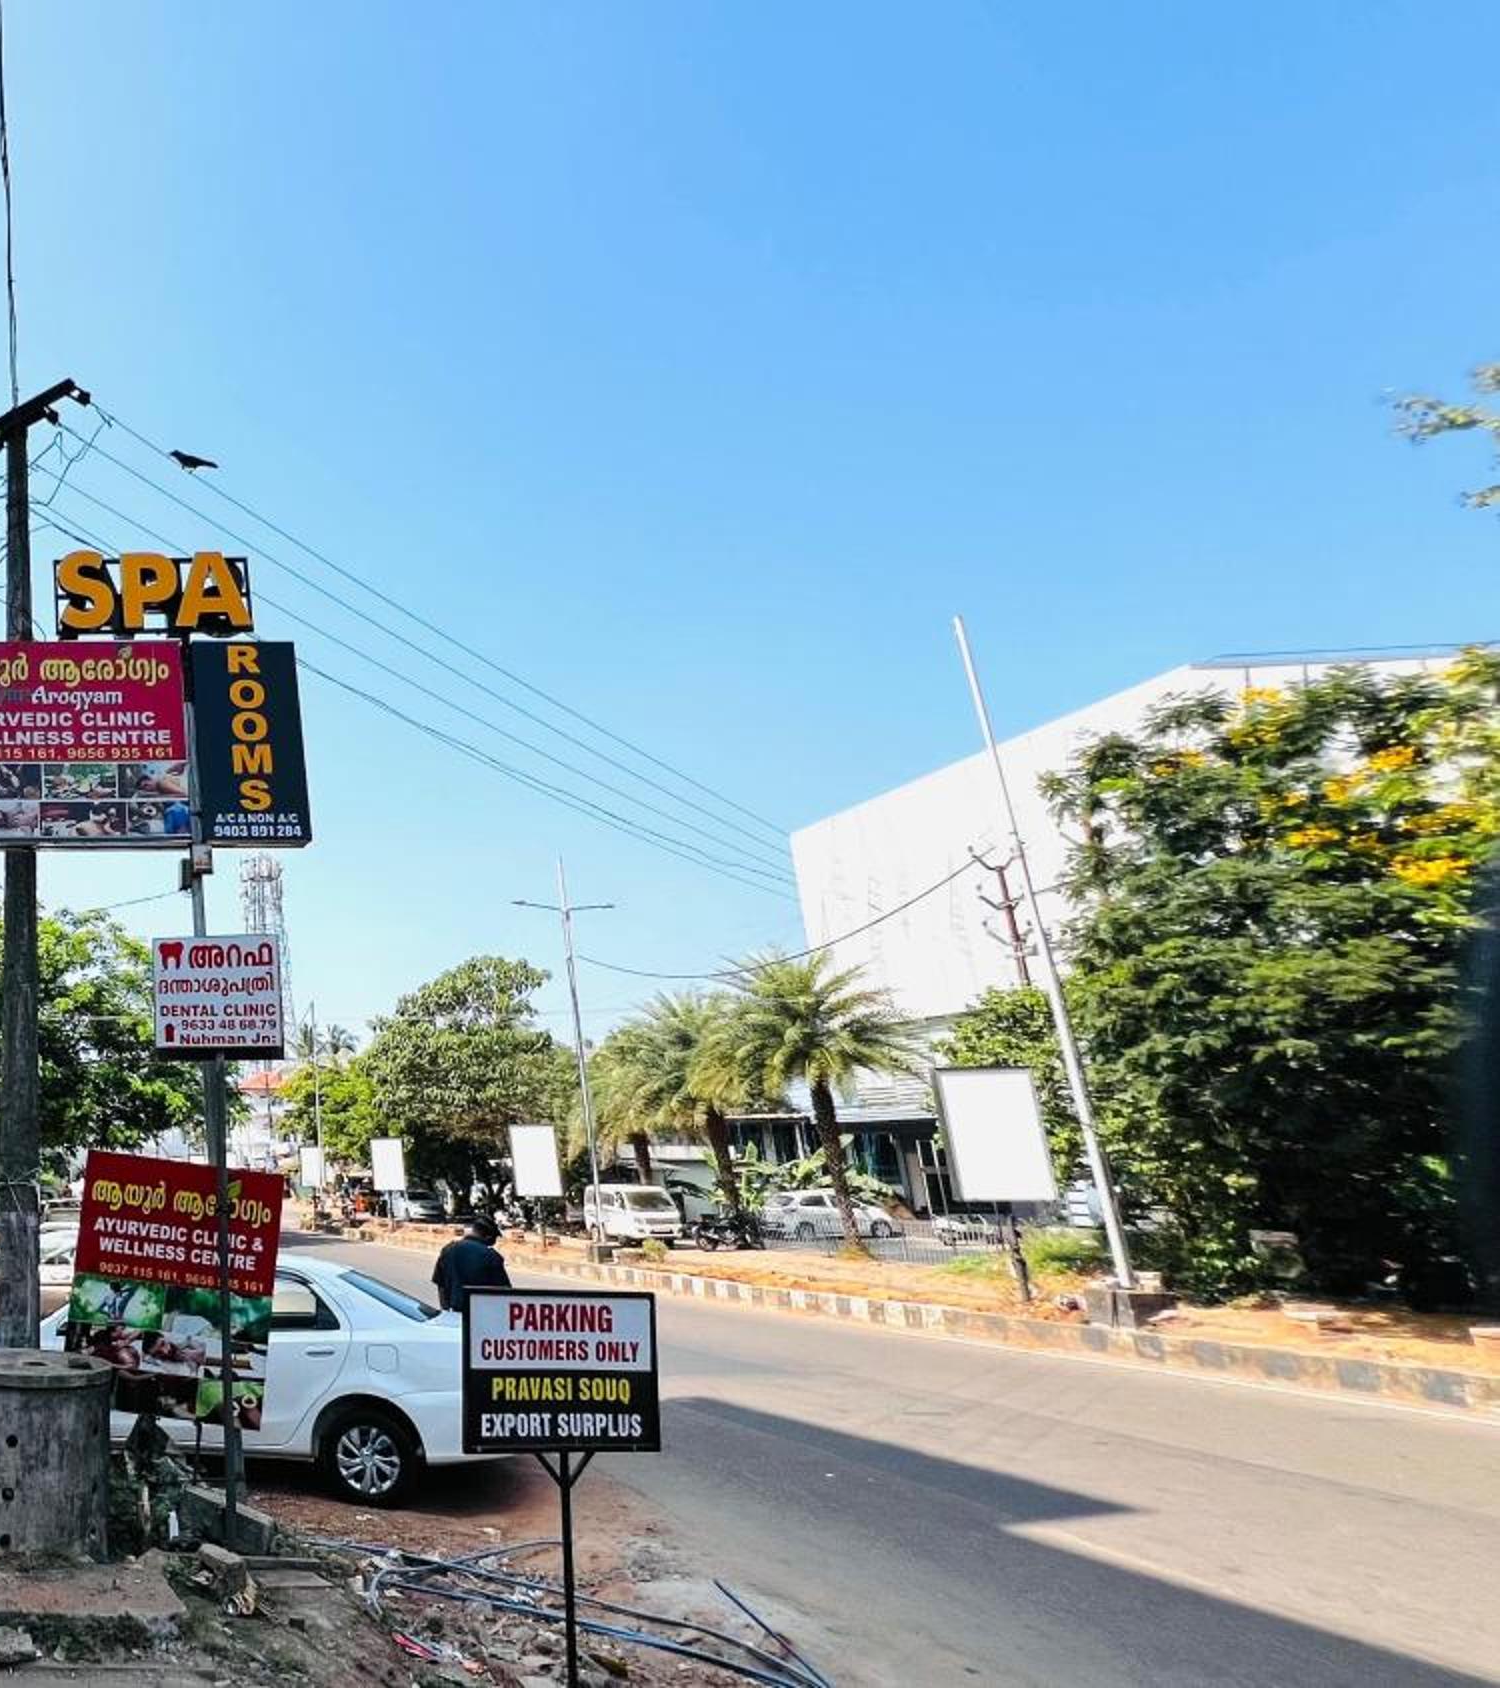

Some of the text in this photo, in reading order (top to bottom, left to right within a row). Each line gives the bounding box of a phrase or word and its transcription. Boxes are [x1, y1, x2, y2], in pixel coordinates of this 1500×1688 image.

[57, 550, 253, 629] SPA
[40, 658, 170, 688] ആരോഗ്യം
[30, 685, 123, 710] Arogyam
[80, 711, 156, 726] CLINIC
[226, 644, 274, 812] ROOMS
[81, 730, 171, 744] CENTRE
[111, 748, 141, 758] 935
[149, 747, 173, 758] 161
[161, 1004, 277, 1017] DENTAL CLINIC
[181, 1019, 215, 1030] 9633
[218, 1020, 236, 1030] 48
[180, 1033, 246, 1045] Nuhman
[93, 1216, 263, 1251] AYURVEDIC CLIIC &
[99, 1238, 185, 1262] WELLNESS
[508, 1302, 613, 1333] PARKING
[481, 1338, 639, 1363] CUSTOMERS ONLY
[492, 1376, 632, 1405] PRAVASI SOUQ
[480, 1413, 642, 1437] EXPORT SURPLUS
